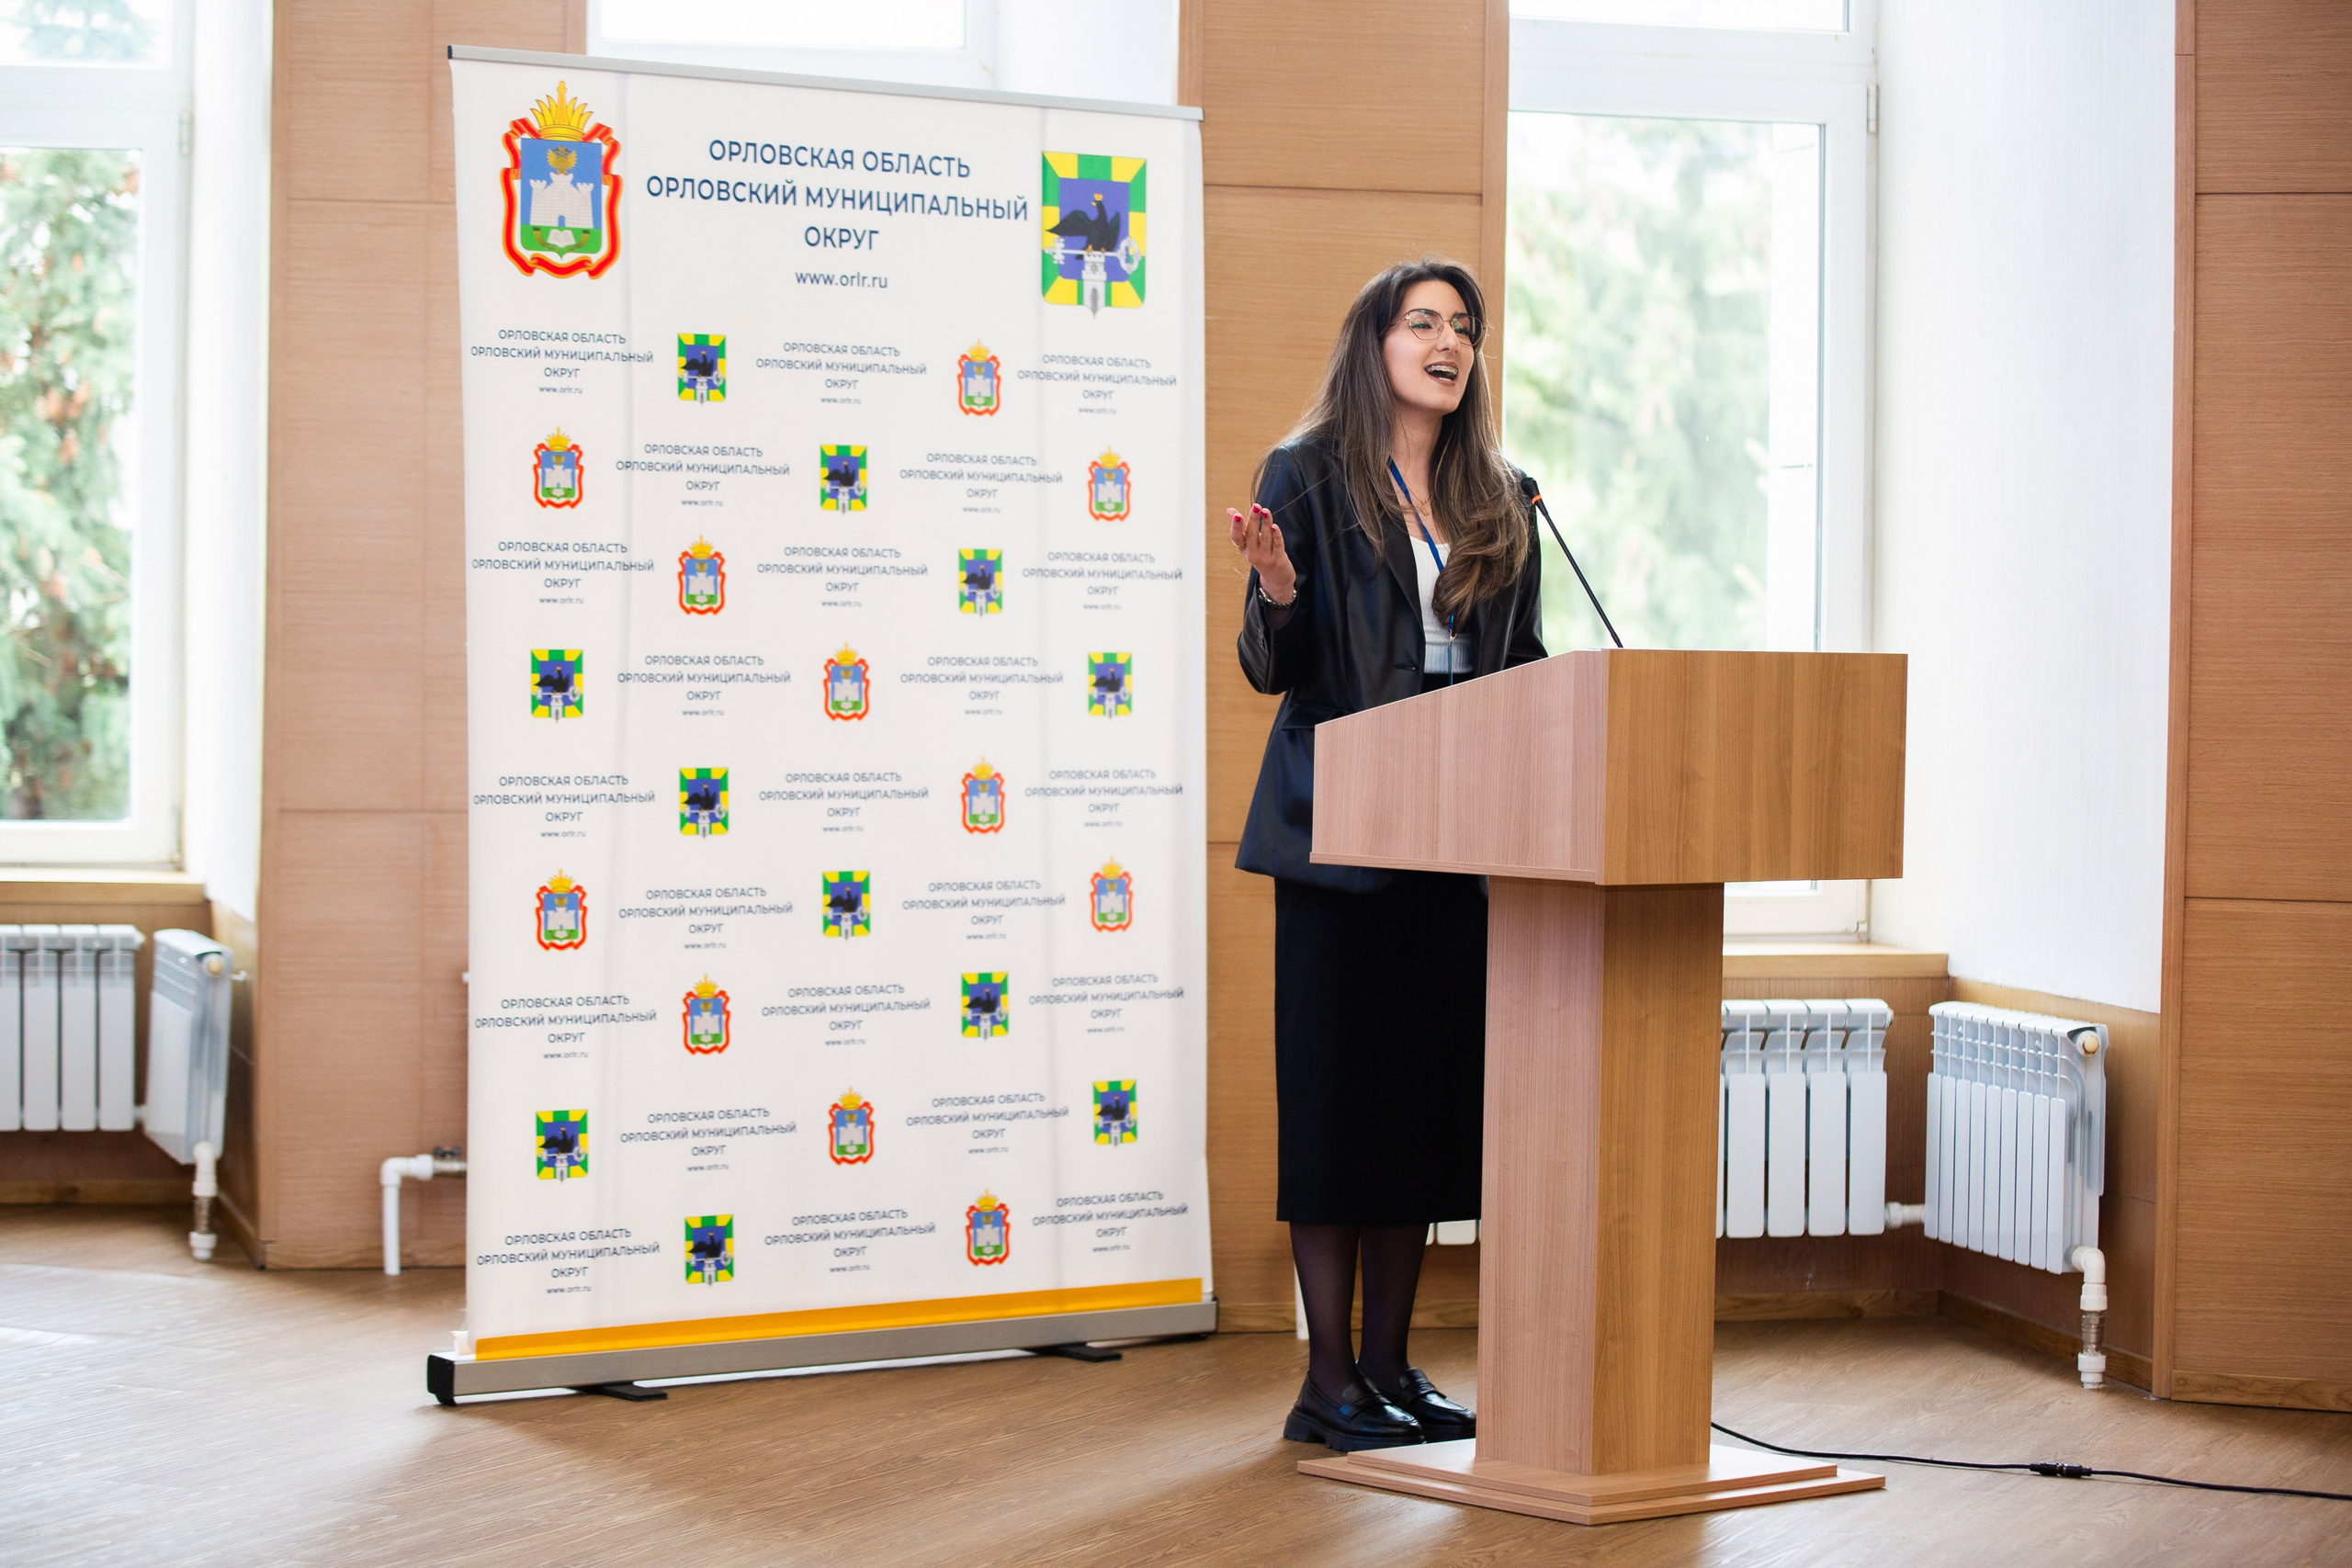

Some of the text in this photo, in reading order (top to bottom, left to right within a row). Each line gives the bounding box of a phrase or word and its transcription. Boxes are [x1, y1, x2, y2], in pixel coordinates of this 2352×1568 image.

[709, 140, 970, 178] ОРЛОВСКАЯ ОБЛАСТЬ
[647, 175, 1027, 220] ОРЛОВСКИЙ МУНИЦИПАЛЬНЫЙ
[805, 226, 879, 250] ОКРУГ
[796, 272, 888, 288] www.orlr.ru
[498, 329, 627, 344] ОРЛОВСКАЯ ОБЛАСТЬ
[470, 345, 653, 363] ОРЛОВСКИЙ МУНИЦИПАЛЬНЫЙ
[783, 342, 900, 356] ОРЛОВСКАЯ ОБЛАСТЬ
[755, 358, 926, 375] ОРЛОВСКИЙ МУНИЦИПАЛЬНЫЙ
[1042, 355, 1151, 368] ОРЛОВСКАЯ ОБЛАСТЬ
[544, 367, 581, 378] ОКРУГ
[1017, 369, 1177, 386] ОРЛОВСКИЙ МУНИЦИПАЛЬНЫЙ
[825, 378, 859, 389] ОКРУГ
[1082, 389, 1114, 400] ОКРУГ
[644, 444, 763, 457] ОРЛОВСКАЯ ОБЛАСТЬ
[926, 453, 1038, 467] ОРЛОВСКАЯ ОБЛАСТЬ
[616, 460, 790, 476] ОРЛОВСКИЙ МУНИЦИПАЛЬНЫЙ
[899, 468, 1062, 483] ОРЛОВСКИЙ МУНИЦИПАЛЬНЫЙ
[685, 480, 720, 491] ОКРУГ
[967, 489, 999, 499] ОКРУГ
[498, 542, 628, 553] ОРЛОВСКАЯ ОБЛАСТЬ
[784, 547, 900, 558] ОРЛОВСКАЯ ОБЛАСТЬ
[1047, 551, 1155, 563] ОРЛОВСКАЯ ОБЛАСТЬ
[471, 558, 654, 572] ОРЛОВСКИЙ МУНИЦИПАЛЬНЫЙ
[757, 562, 928, 576] ОРЛОВСКИЙ МУНИЦИПАЛЬНЫЙ
[1022, 567, 1183, 581] ОРЛОВСКИЙ МУНИЦИПАЛЬНЫЙ
[544, 578, 582, 588] ОКРУГ
[825, 582, 860, 592] ОКРУГ
[1087, 586, 1119, 595] ОКРУГ
[645, 655, 764, 665] ОРЛОВСКАЯ ОБЛАСТЬ
[927, 656, 1038, 667] ОРЛОВСКАЯ ОБЛАСТЬ
[617, 671, 791, 684] ОРЛОВСКИЙ МУНИЦИПАЛЬНЫЙ
[900, 671, 1064, 685] ОРЛОВСКИЙ МУНИЦИПАЛЬНЫЙ
[686, 691, 722, 701] ОКРУГ
[968, 691, 1001, 700] ОКРУГ
[499, 774, 628, 786] ОРЛОВСКАЯ ОБЛАСТЬ
[786, 772, 902, 783] ОРЛОВСКАЯ ОБЛАСТЬ
[1049, 769, 1156, 780] ОРЛОВСКАЯ ОБЛАСТЬ
[759, 787, 929, 801] ОРЛОВСКИЙ МУНИЦИПАЛЬНЫЙ
[1024, 784, 1183, 797] ОРЛОВСКИЙ МУНИЦИПАЛЬНЫЙ
[473, 791, 655, 805] ОРЛОВСКИЙ МУНИЦИПАЛЬНЫЙ
[827, 807, 862, 818] ОКРУГ
[1088, 803, 1120, 813] ОКРУГ
[546, 811, 583, 822] ОКРУГ
[928, 880, 1042, 893] ОРЛОВСКАЯ ОБЛАСТЬ
[646, 887, 767, 900] ОРЛОВСКАЯ ОБЛАСТЬ
[902, 894, 1066, 910] ОРЛОВСКИЙ МУНИЦИПАЛЬНЫЙ
[618, 902, 793, 919] ОРЛОВСКИЙ МУНИЦИПАЛЬНЫЙ
[970, 915, 1004, 925] ОКРУГ
[688, 923, 724, 934] ОКРУГ
[1051, 974, 1159, 987] ОРЛОВСКАЯ ОБЛАСТЬ
[788, 985, 905, 998] ОРЛОВСКАЯ ОБЛАСТЬ
[1028, 987, 1184, 1005] ОРЛОВСКИЙ МУНИЦИПАЛЬНЫЙ
[501, 995, 630, 1009] ОРЛОВСКАЯ ОБЛАСТЬ
[761, 998, 931, 1016] ОРЛОВСКИЙ МУНИЦИПАЛЬНЫЙ
[474, 1010, 657, 1029] ОРЛОВСКИЙ МУНИЦИПАЛЬНЫЙ
[1091, 1009, 1123, 1019] ОКРУГ
[829, 1020, 864, 1031] ОКРУГ
[548, 1032, 586, 1043] ОКРУГ
[932, 1092, 1046, 1108] ОРЛОВСКАЯ ОБЛАСТЬ
[647, 1108, 770, 1123] ОРЛОВСКАЯ ОБЛАСТЬ
[906, 1106, 1069, 1126] ОРЛОВСКИЙ МУНИЦИПАЛЬНЫЙ
[619, 1122, 797, 1143] ОРЛОВСКИЙ МУНИЦИПАЛЬНЫЙ
[972, 1128, 1007, 1139] ОКРУГ
[691, 1145, 727, 1156] ОКРУГ
[1055, 1190, 1165, 1209] ОРЛОВСКАЯ ОБЛАСТЬ
[792, 1209, 909, 1226] ОРЛОВСКАЯ ОБЛАСТЬ
[1032, 1202, 1189, 1226] ОРЛОВСКИЙ МУНИЦИПАЛЬНЫЙ
[504, 1228, 632, 1246] ОРЛОВСКАЯ ОБЛАСТЬ
[764, 1222, 936, 1246] ОРЛОВСКИЙ МУНИЦИПАЛЬНЫЙ
[1095, 1225, 1128, 1238] ОКРУГ
[476, 1242, 660, 1266] ОРЛОВСКИЙ МУНИЦИПАЛЬНЫЙ
[833, 1246, 867, 1258] ОКРУГ
[551, 1267, 590, 1279] ОКРУГ
